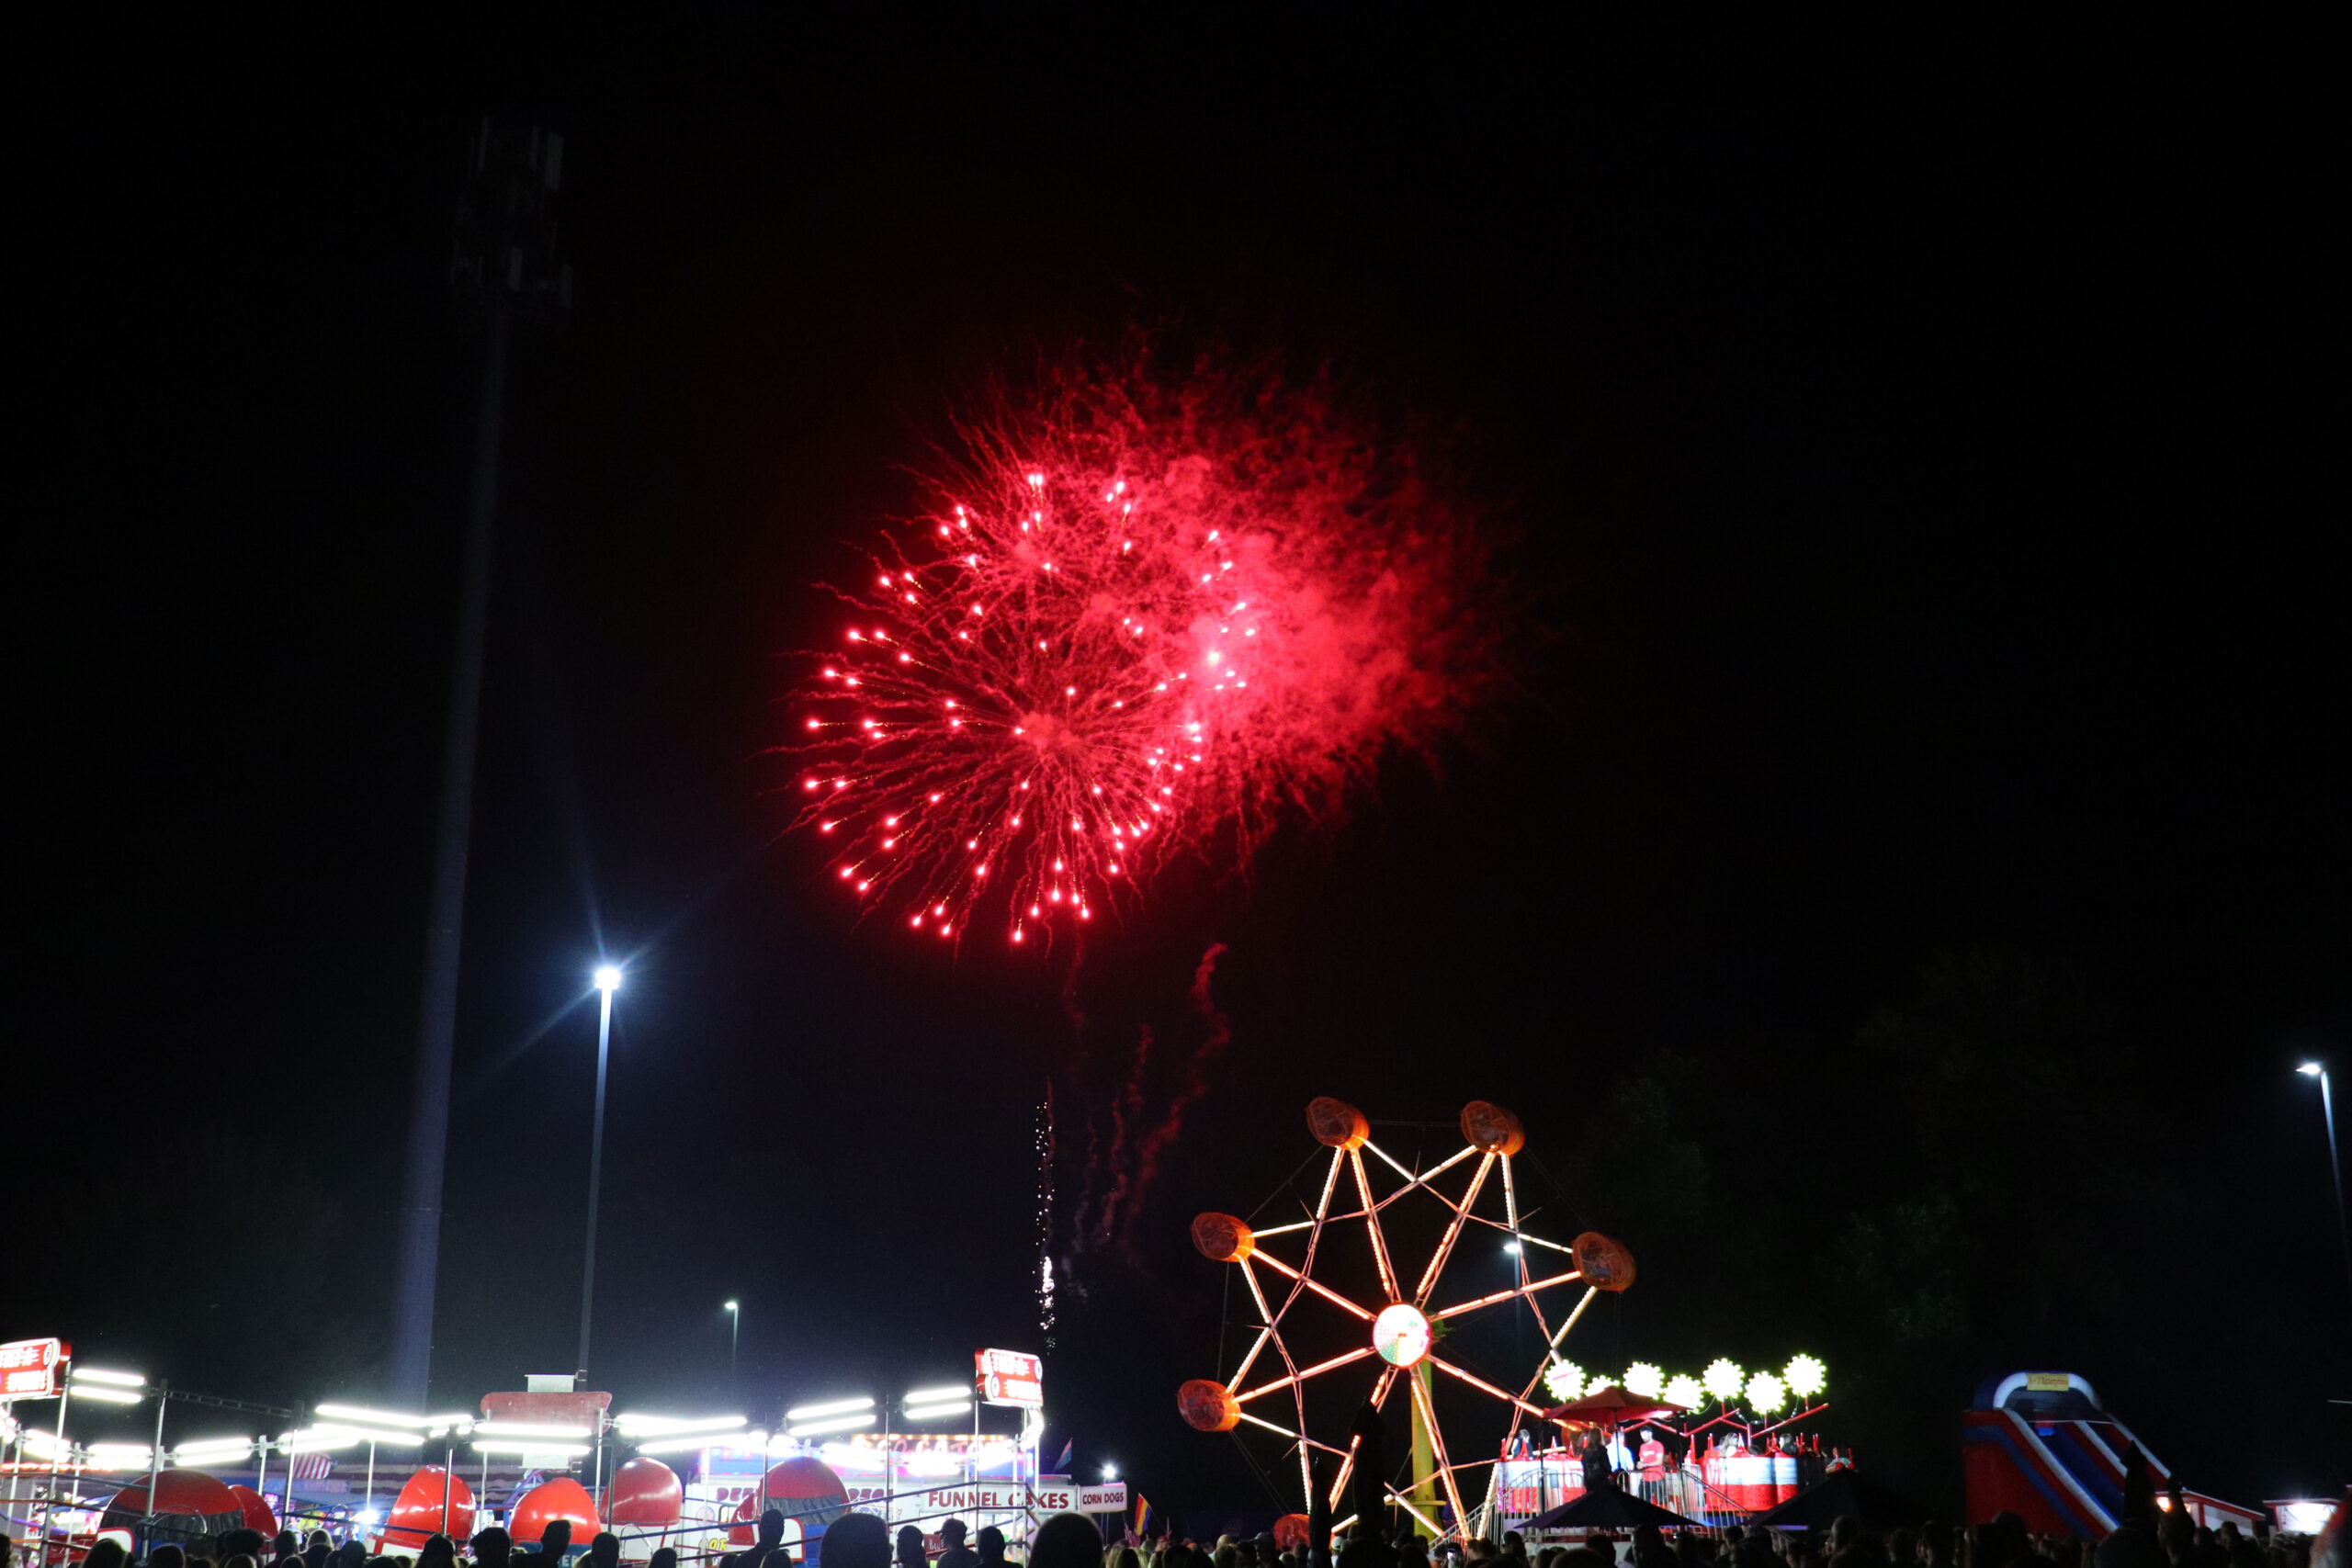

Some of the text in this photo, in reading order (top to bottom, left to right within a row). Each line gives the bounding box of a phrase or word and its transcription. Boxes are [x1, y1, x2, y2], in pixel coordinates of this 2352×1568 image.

[928, 1492, 1069, 1509] FUNNEL CAKES
[1082, 1492, 1124, 1505] CORN DOGS
